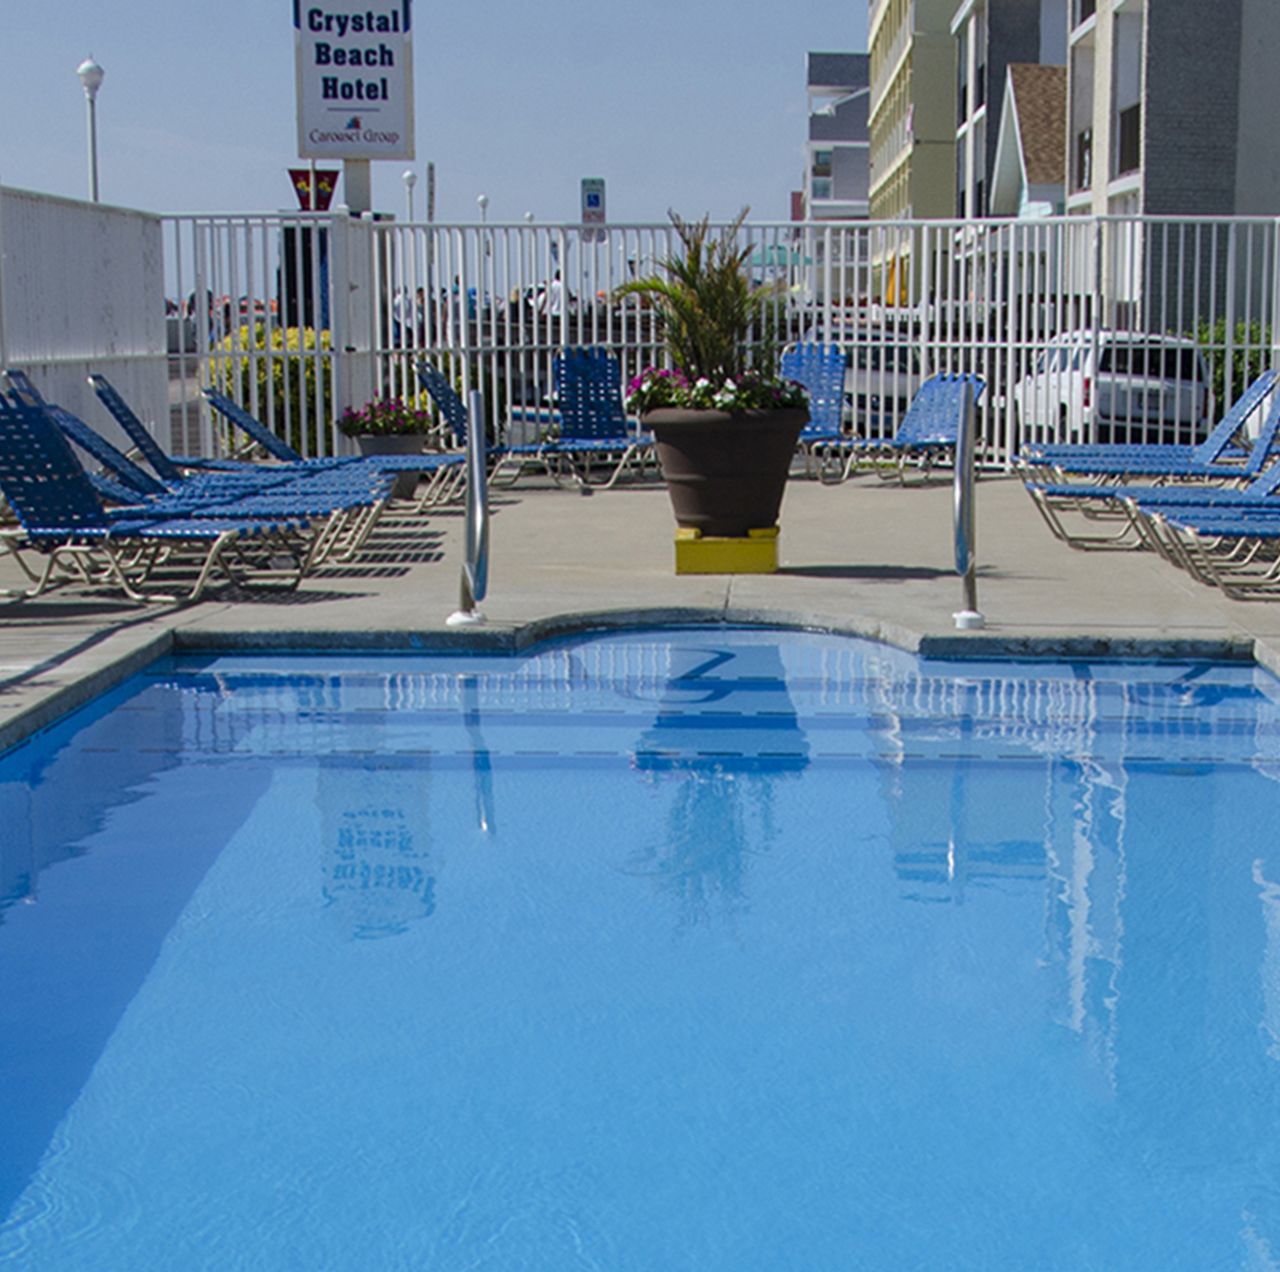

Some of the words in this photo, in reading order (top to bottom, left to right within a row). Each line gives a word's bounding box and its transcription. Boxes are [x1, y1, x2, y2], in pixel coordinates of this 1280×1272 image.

[308, 8, 400, 37] Crystal
[315, 42, 394, 67] Beach
[322, 76, 389, 101] Hotel
